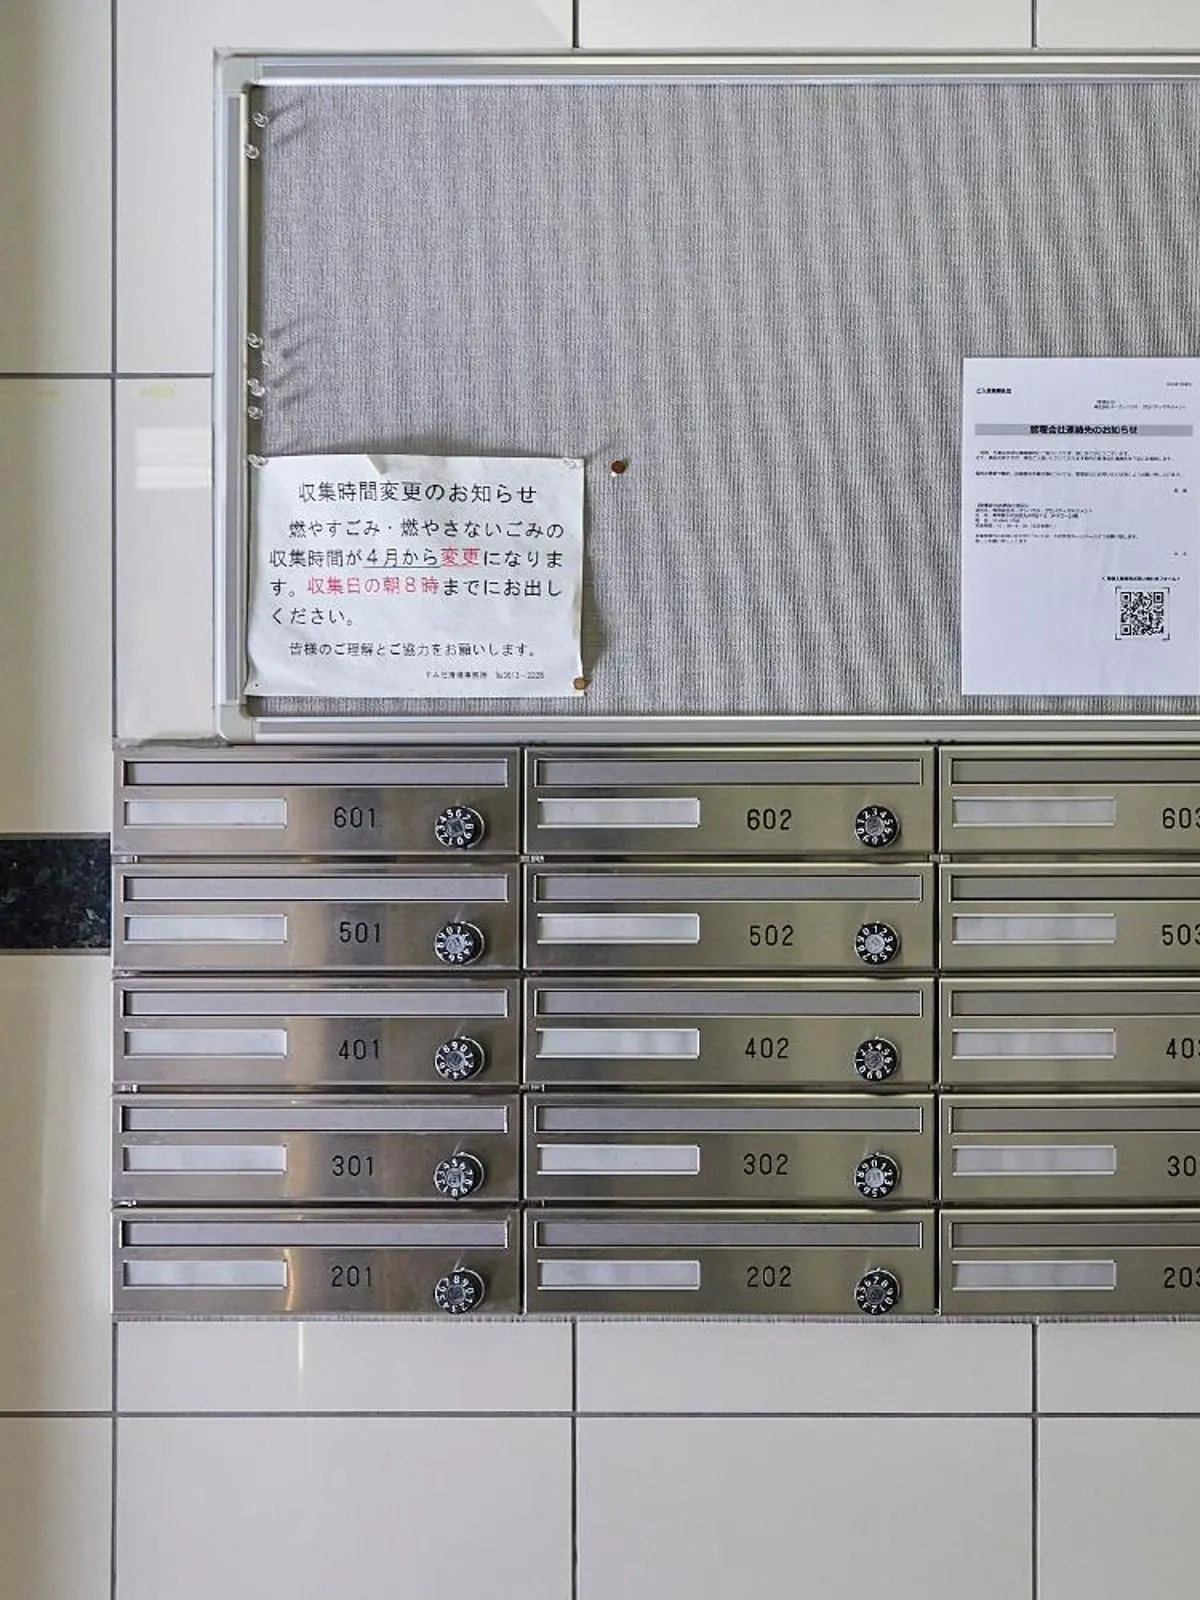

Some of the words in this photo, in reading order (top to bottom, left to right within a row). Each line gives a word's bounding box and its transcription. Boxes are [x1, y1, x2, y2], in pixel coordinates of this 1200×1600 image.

[299, 481, 537, 503] 収集時間変更のお知らせ
[271, 607, 354, 627] ください。
[289, 642, 535, 657] 皆様のご理解とご協力をお願いします。
[333, 806, 375, 829] 601
[746, 807, 793, 832] 602
[339, 920, 380, 944] 501
[749, 924, 795, 947] 502
[338, 1038, 379, 1061] 401
[744, 1036, 790, 1059] 402
[331, 1154, 373, 1177] 301
[743, 1152, 789, 1176] 302
[331, 1264, 372, 1288] 201
[746, 1264, 792, 1288] 202
